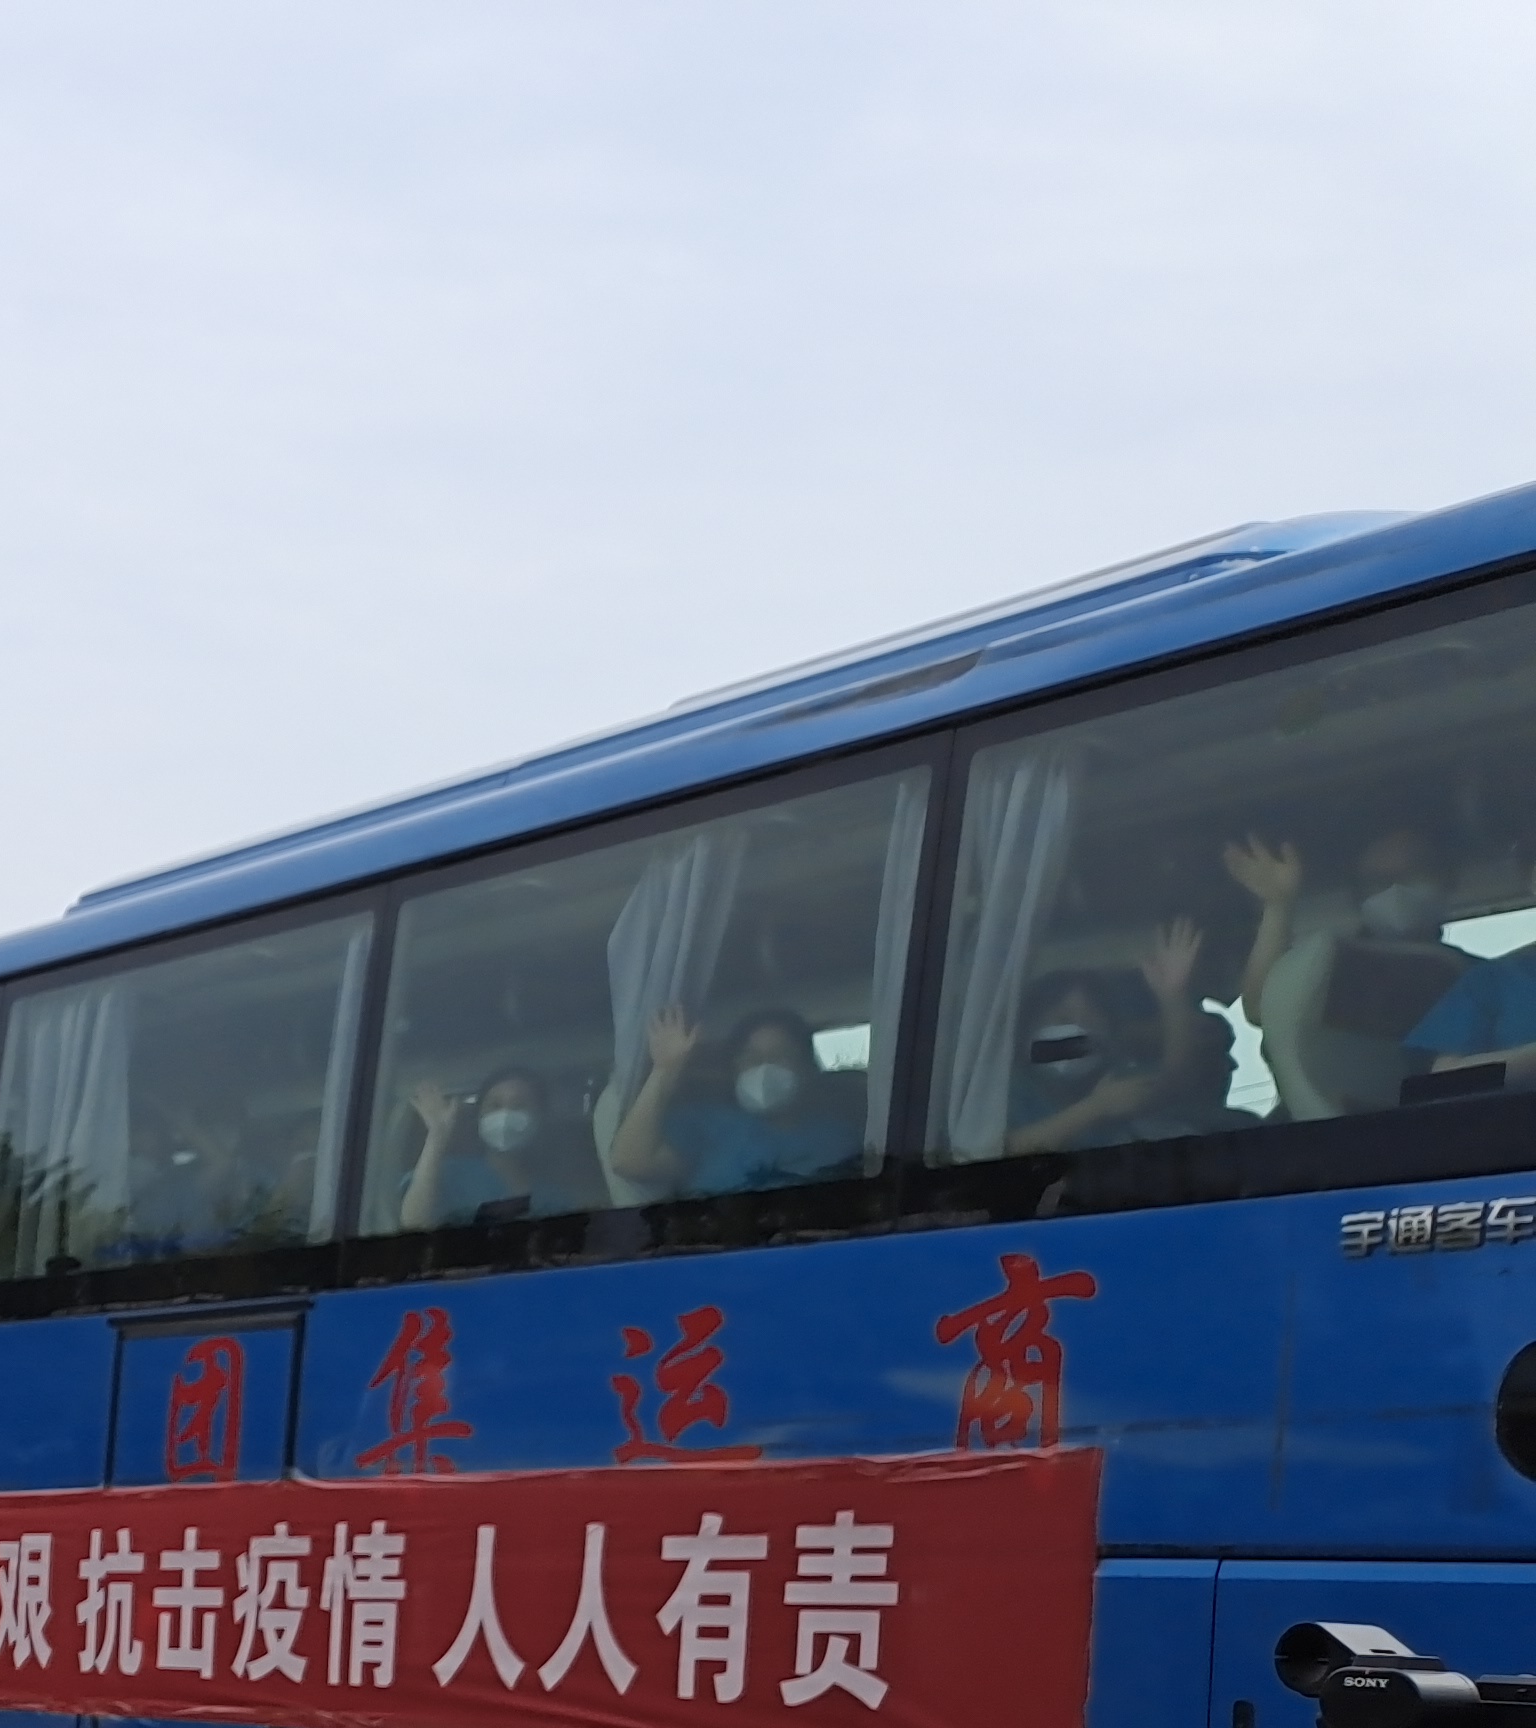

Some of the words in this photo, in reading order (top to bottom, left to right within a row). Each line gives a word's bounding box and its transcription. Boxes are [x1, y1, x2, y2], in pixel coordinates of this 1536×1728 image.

[1340, 1197, 1536, 1257] 宇通客车
[76, 1521, 407, 1688] 抗击疫情
[431, 1510, 899, 1710] 人人有责
[1343, 1676, 1390, 1688] SONY
